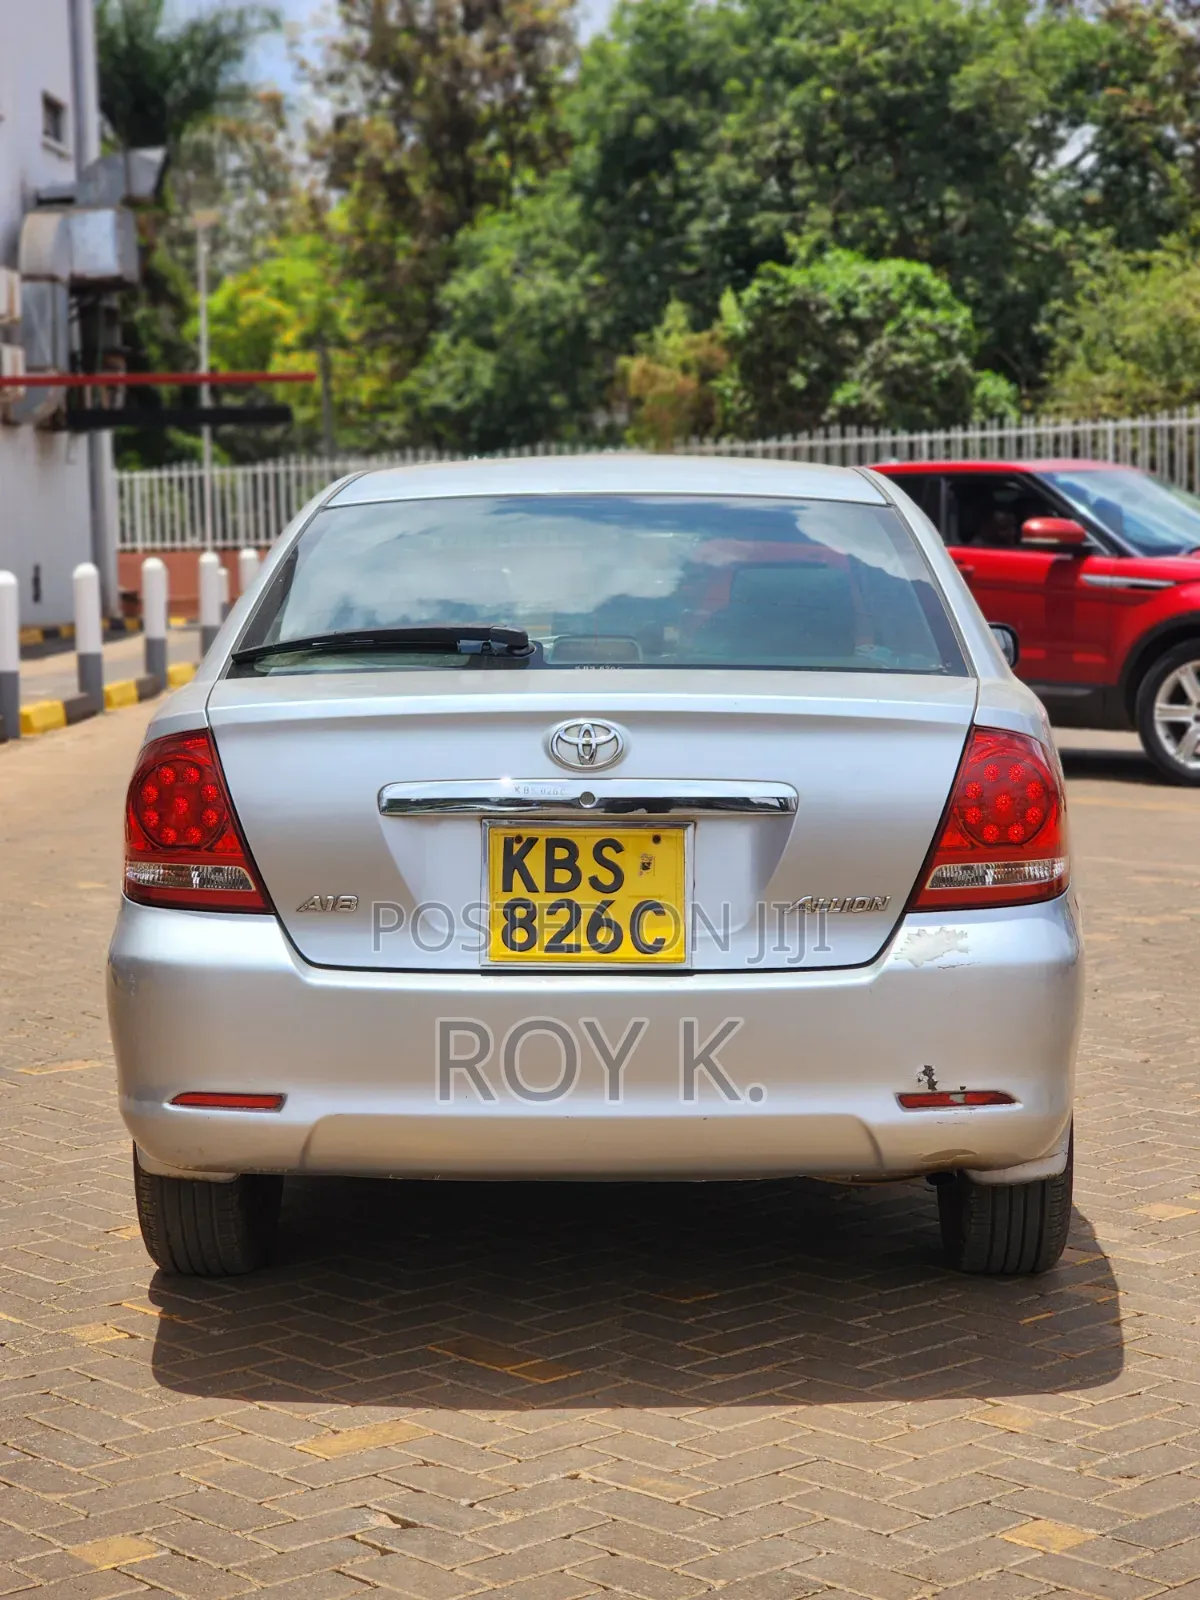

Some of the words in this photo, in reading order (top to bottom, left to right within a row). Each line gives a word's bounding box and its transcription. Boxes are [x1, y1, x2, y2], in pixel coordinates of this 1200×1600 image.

[501, 836, 625, 894] KBS
[501, 897, 666, 955] 826C
[784, 895, 891, 914] ALLION
